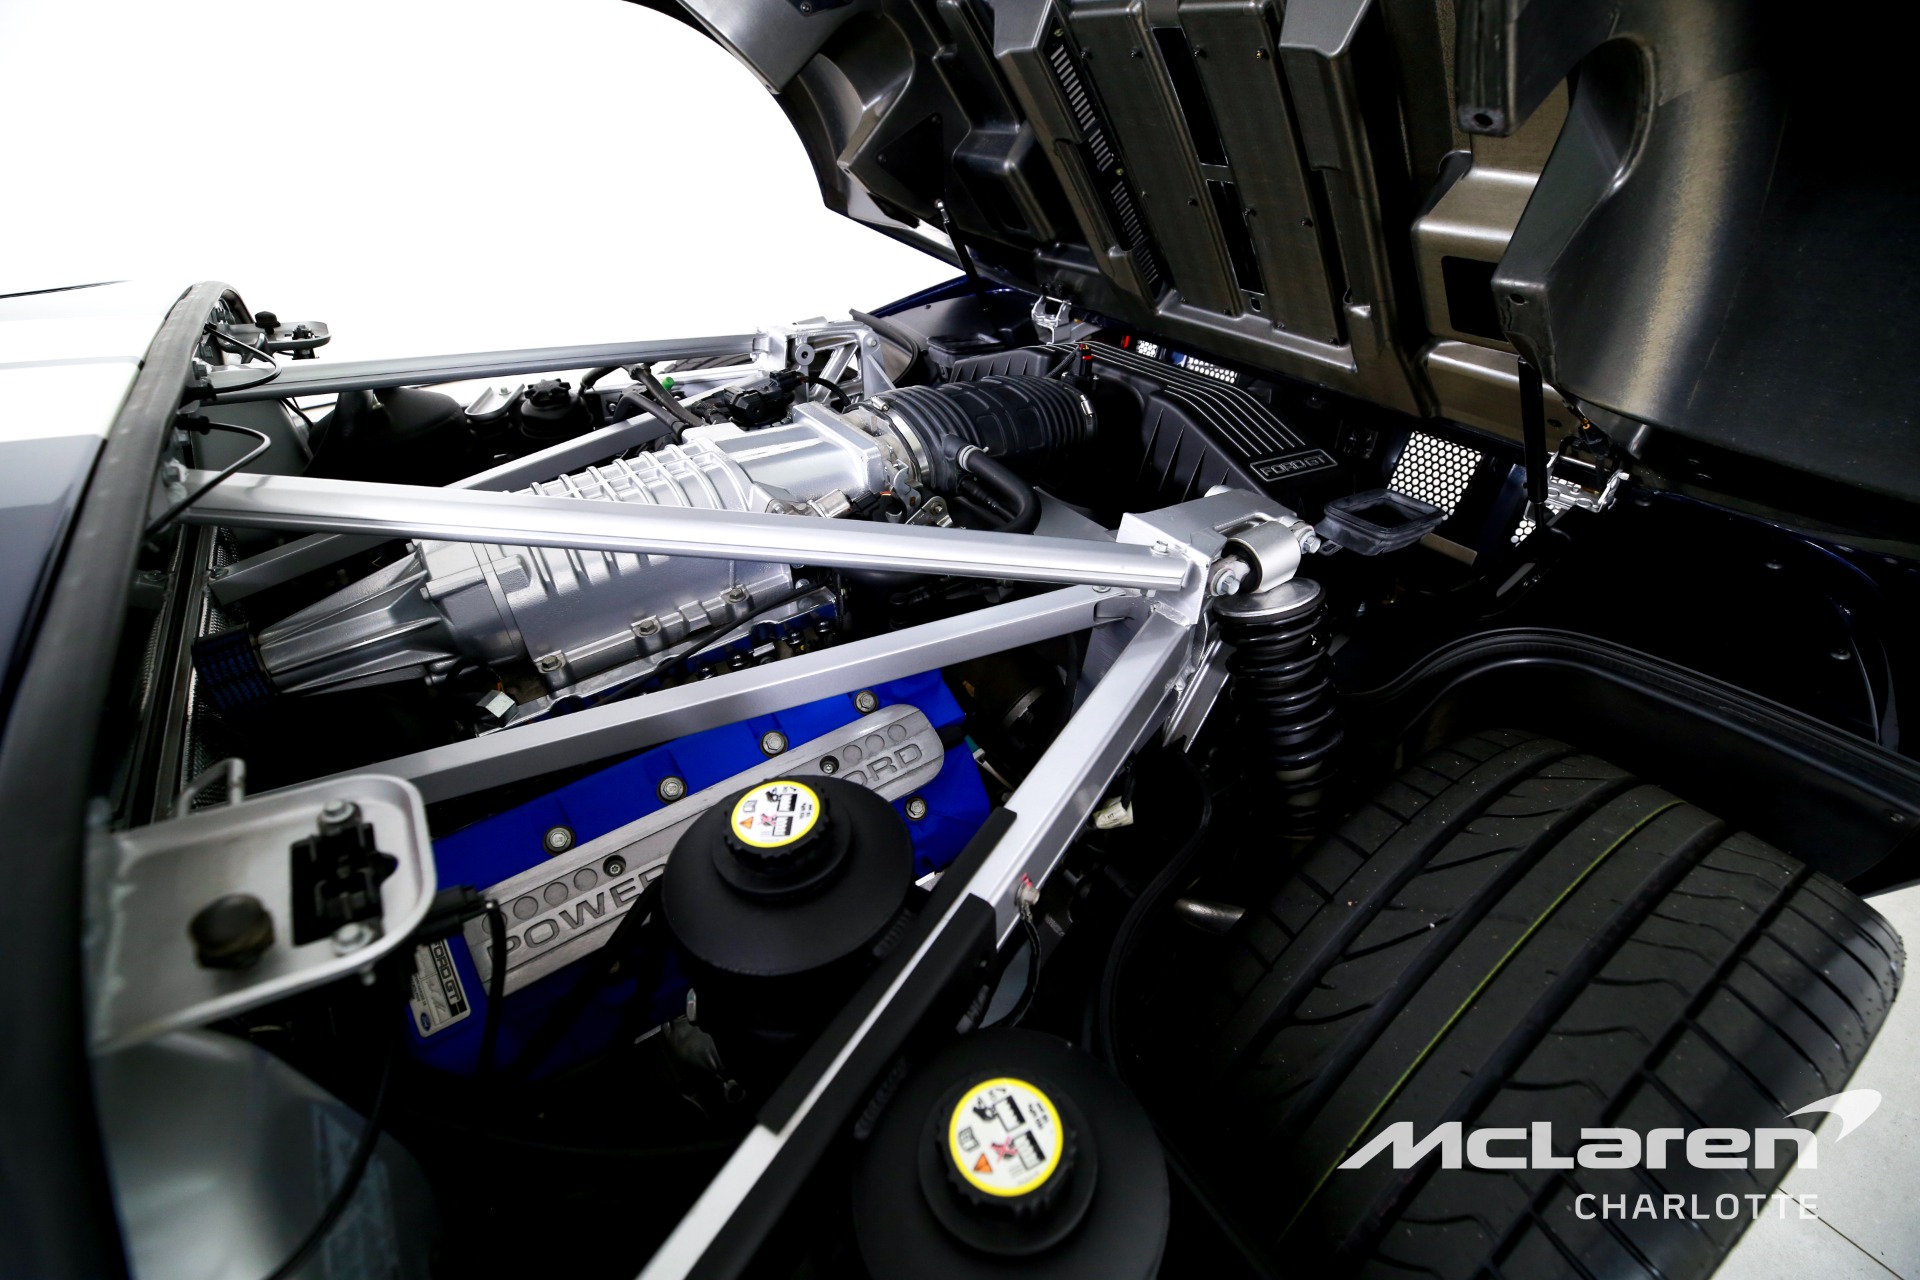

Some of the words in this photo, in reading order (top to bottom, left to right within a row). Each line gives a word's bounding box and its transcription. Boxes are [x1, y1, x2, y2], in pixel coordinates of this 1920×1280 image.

[1260, 460, 1306, 476] FORD
[1304, 455, 1326, 466] GT
[842, 743, 923, 786] ORD
[445, 980, 460, 1000] GT
